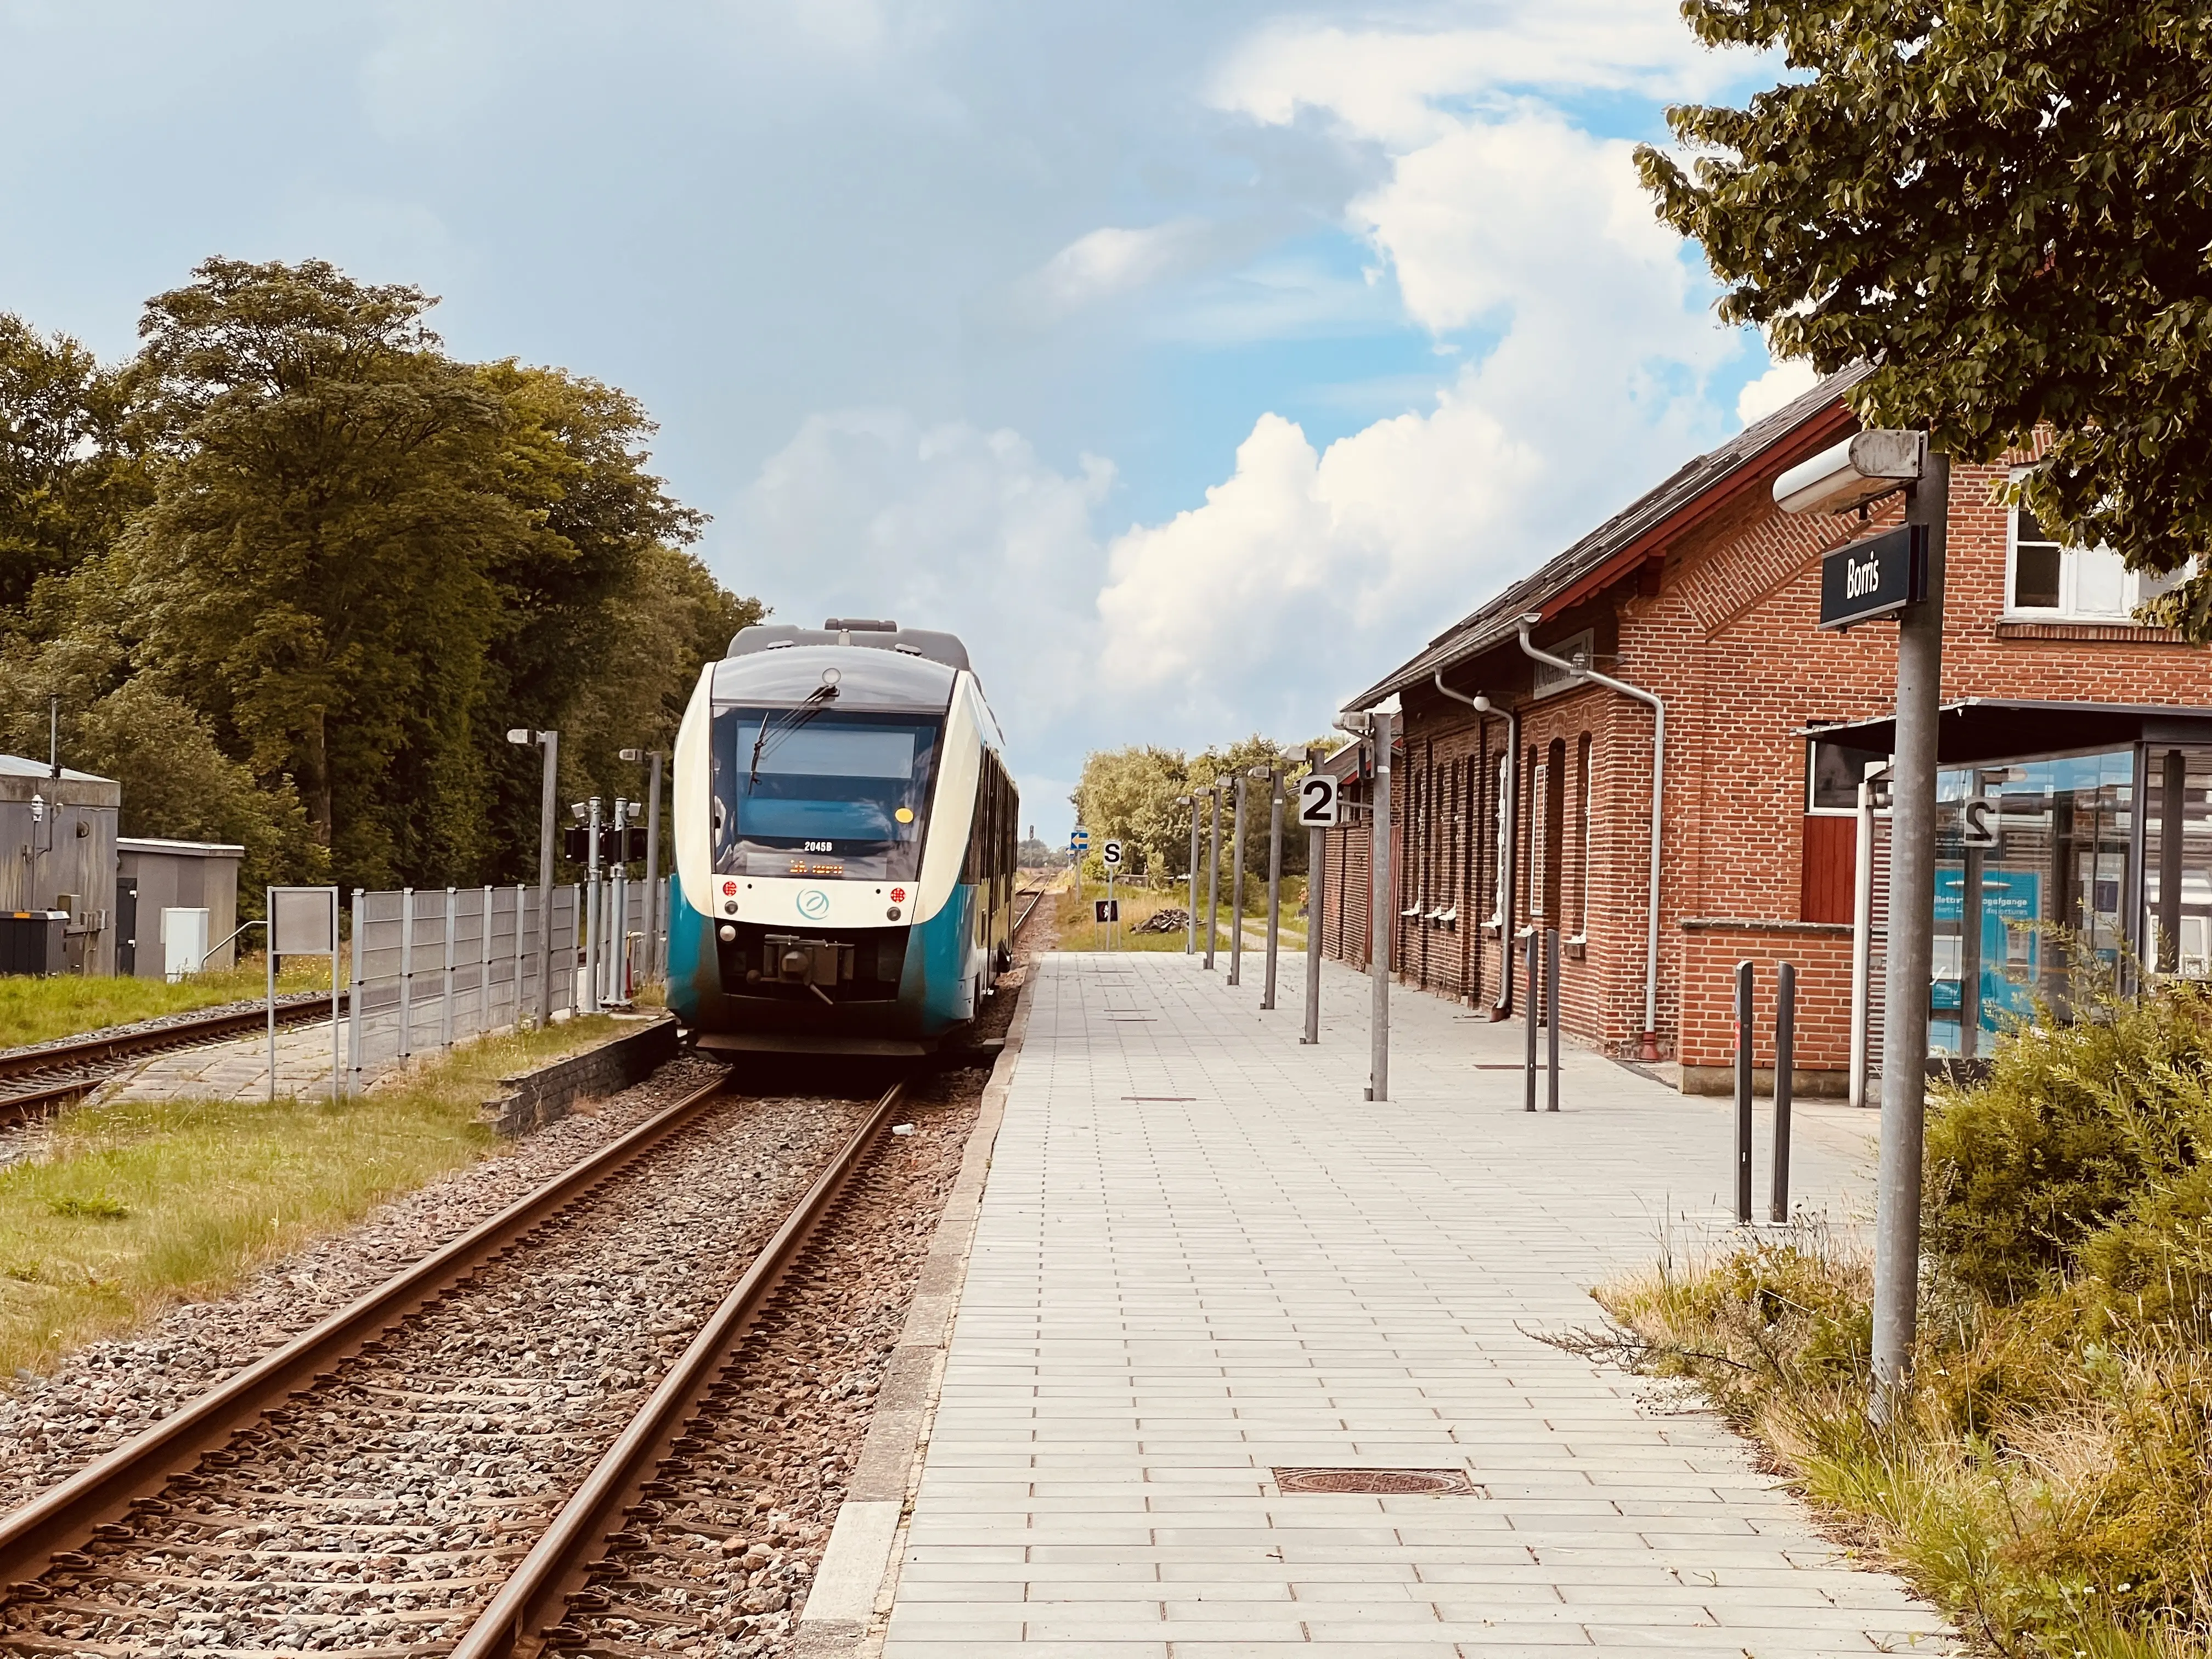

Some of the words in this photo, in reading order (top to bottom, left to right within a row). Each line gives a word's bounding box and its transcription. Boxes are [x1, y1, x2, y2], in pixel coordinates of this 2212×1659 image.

[1847, 550, 1879, 599] Borris
[1303, 780, 1333, 821] 2
[804, 841, 833, 852] 2045B
[1104, 843, 1120, 863] S
